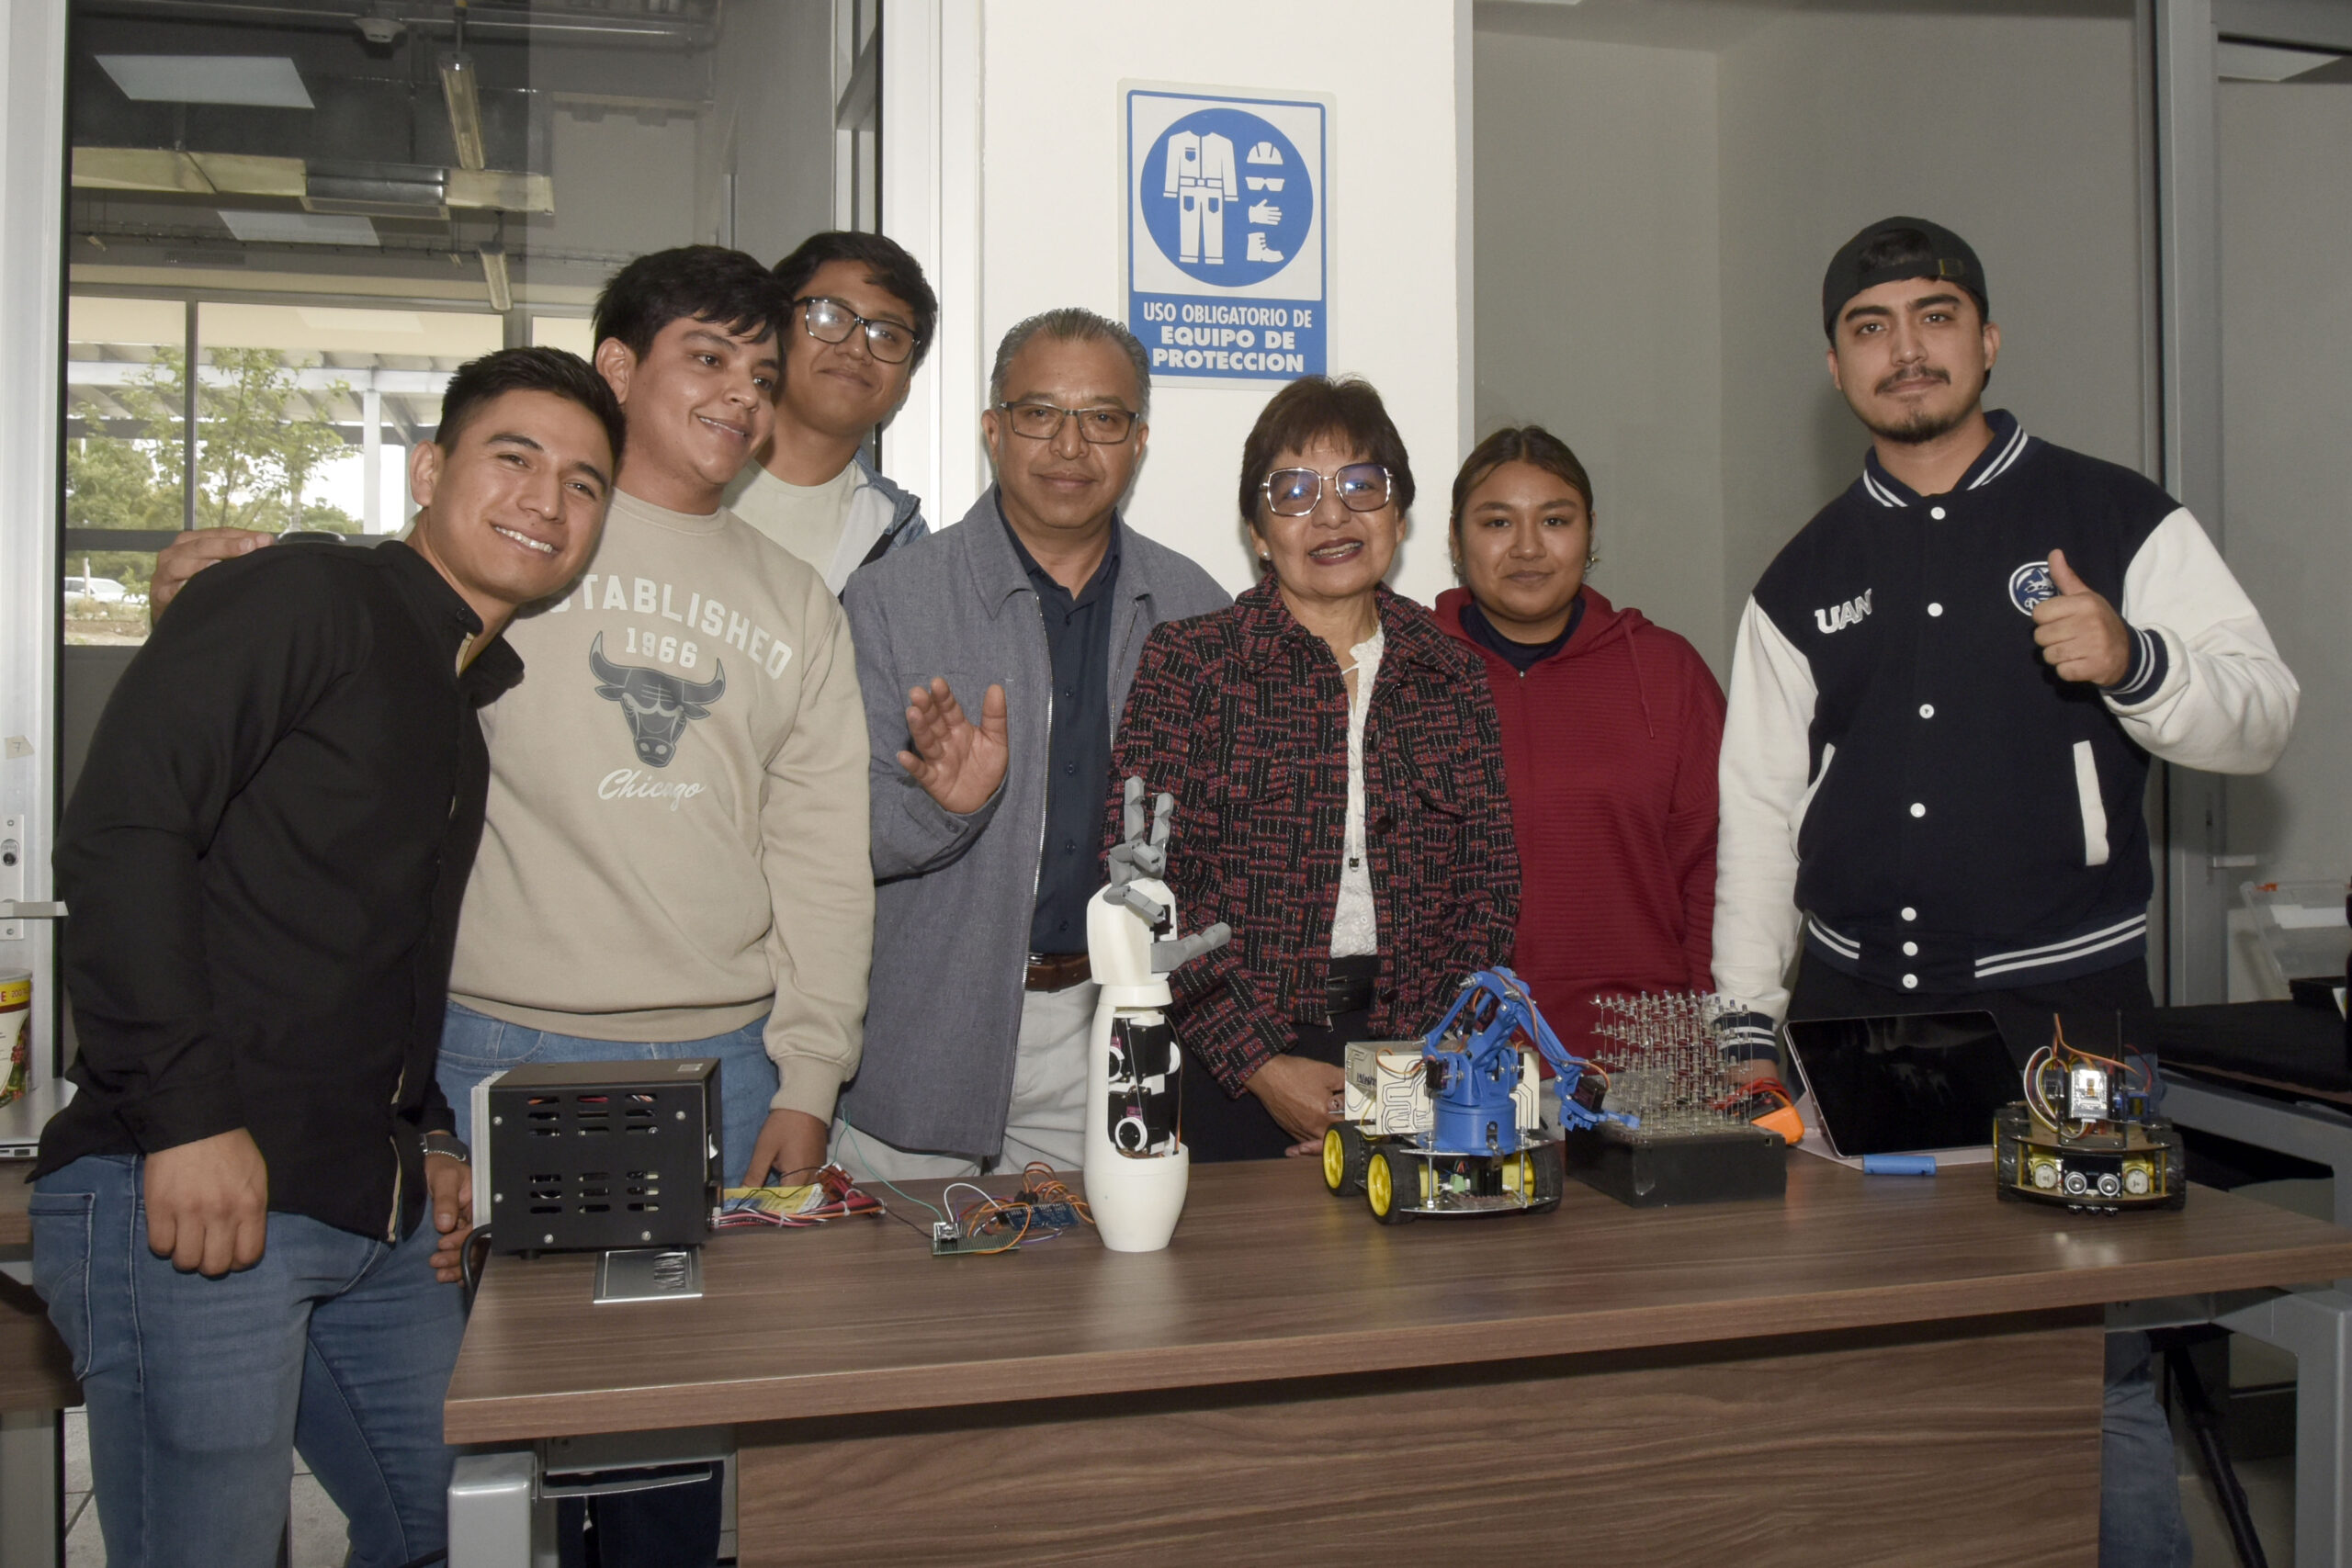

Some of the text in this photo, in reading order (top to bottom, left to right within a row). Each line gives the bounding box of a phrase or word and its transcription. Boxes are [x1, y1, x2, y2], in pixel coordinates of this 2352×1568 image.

[1143, 301, 1312, 328] USO OBLIGATORIO DE
[1160, 325, 1295, 350] EQUIPO DE
[1152, 348, 1304, 373] PROTECCION
[1815, 588, 1872, 634] UAN
[626, 626, 698, 669] 1966
[597, 768, 706, 811] Chicago
